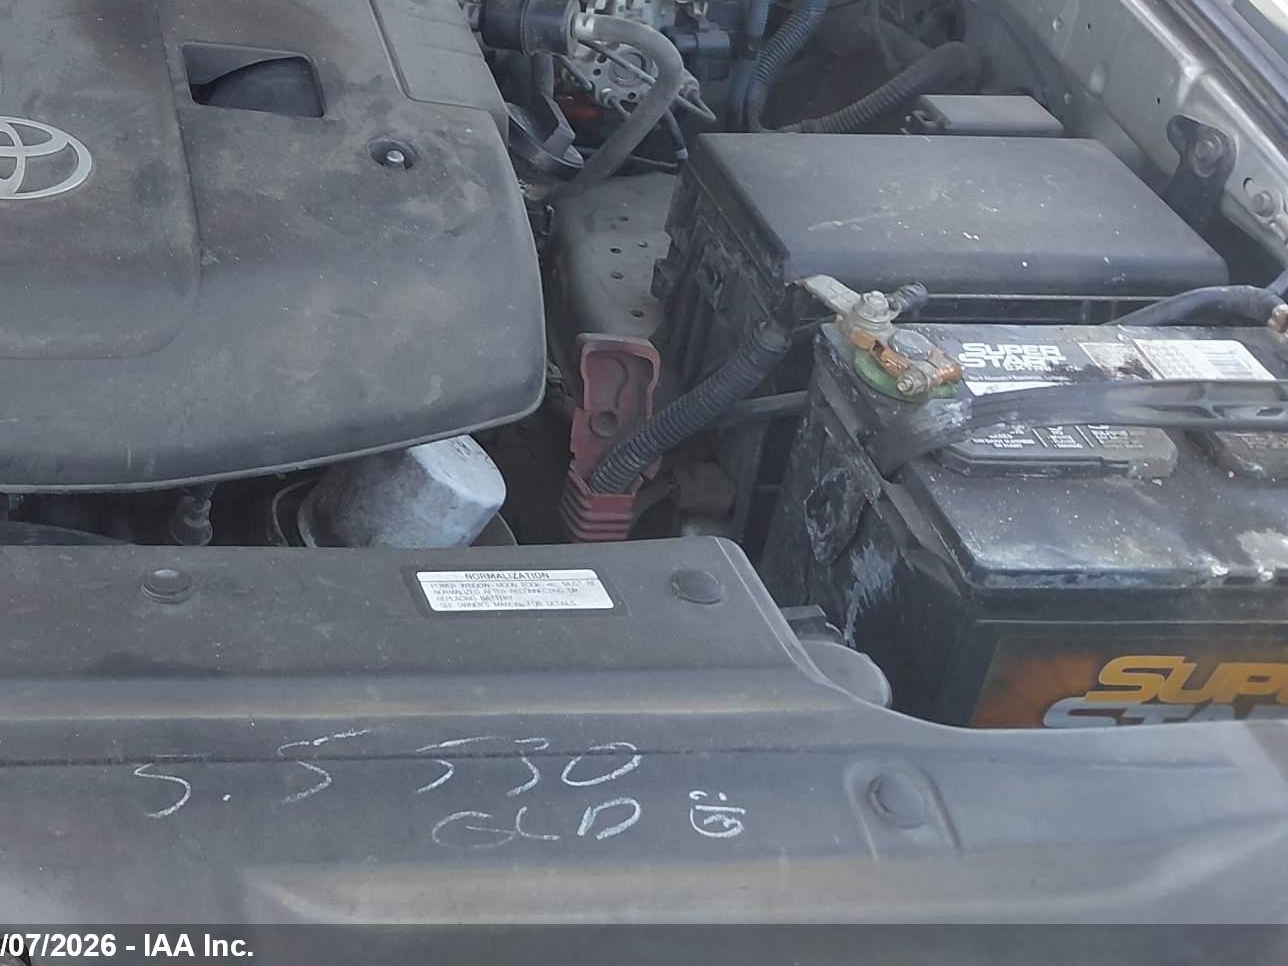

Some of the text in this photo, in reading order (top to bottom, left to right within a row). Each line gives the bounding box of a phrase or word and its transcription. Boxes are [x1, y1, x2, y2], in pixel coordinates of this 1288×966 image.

[961, 342, 1062, 357] SUPER
[958, 353, 1067, 368] START
[464, 571, 550, 580] NORMALIZATION
[1083, 655, 1288, 704] SUP
